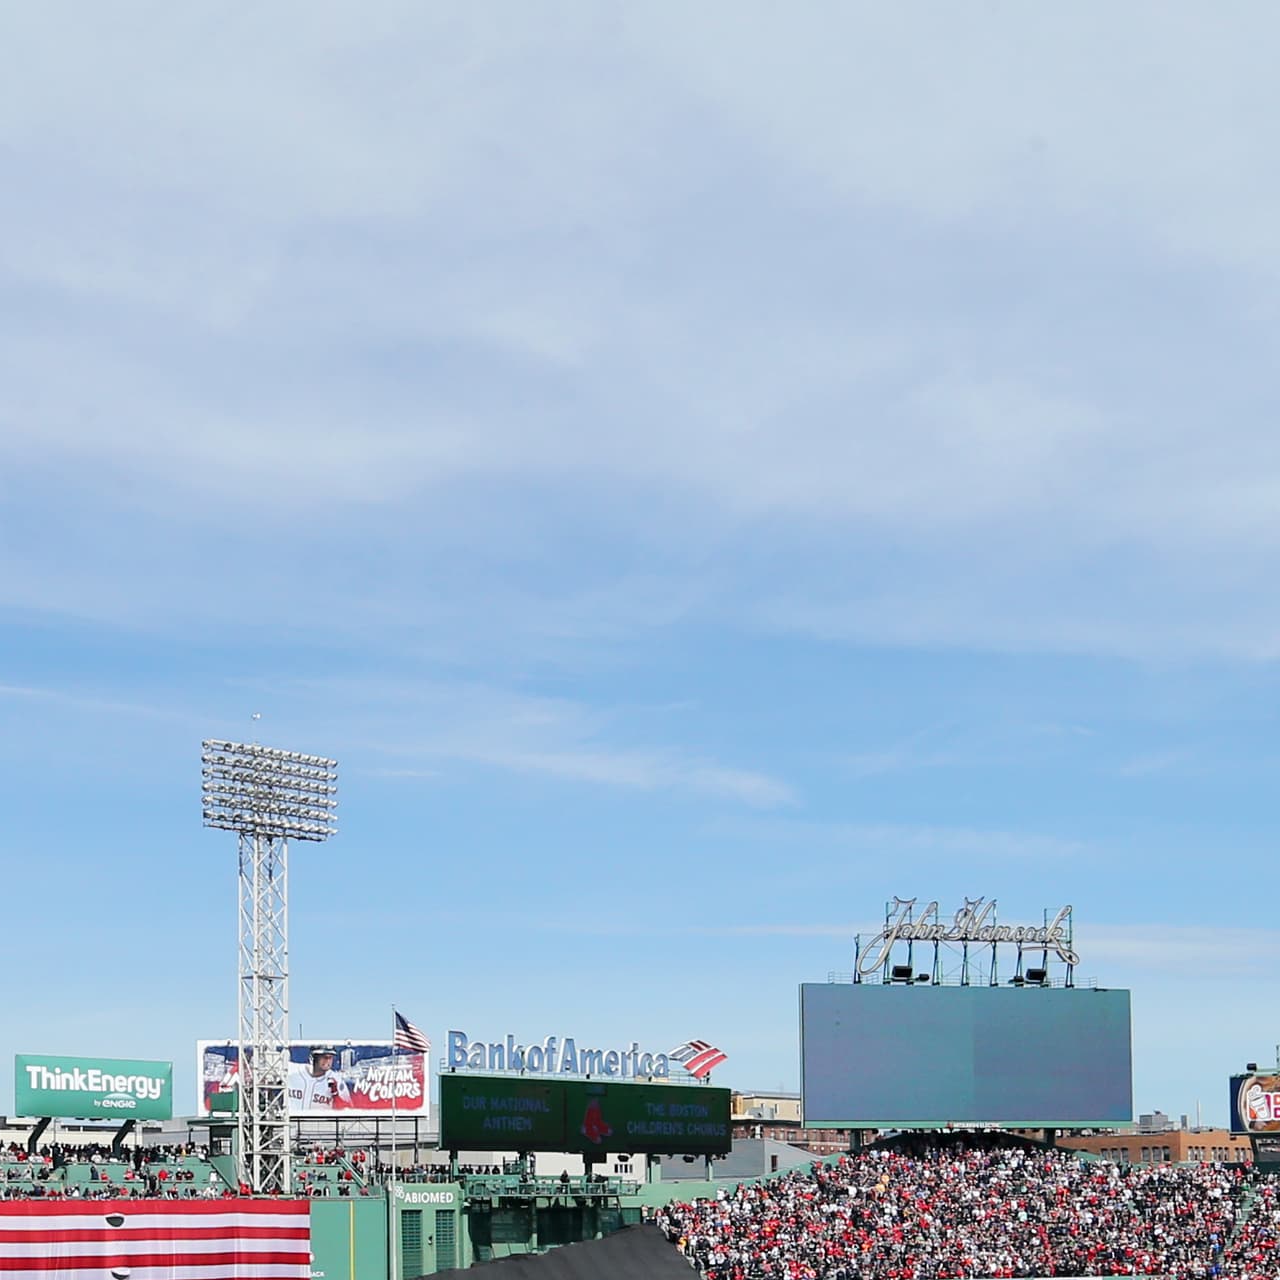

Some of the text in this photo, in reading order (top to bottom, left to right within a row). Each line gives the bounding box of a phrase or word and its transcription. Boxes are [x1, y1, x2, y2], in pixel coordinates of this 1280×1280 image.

[857, 896, 1079, 975] John Hancock
[447, 1030, 669, 1078] Bank of America
[25, 1065, 162, 1099] ThinkEnergy
[404, 1192, 454, 1204] ABIOMED
